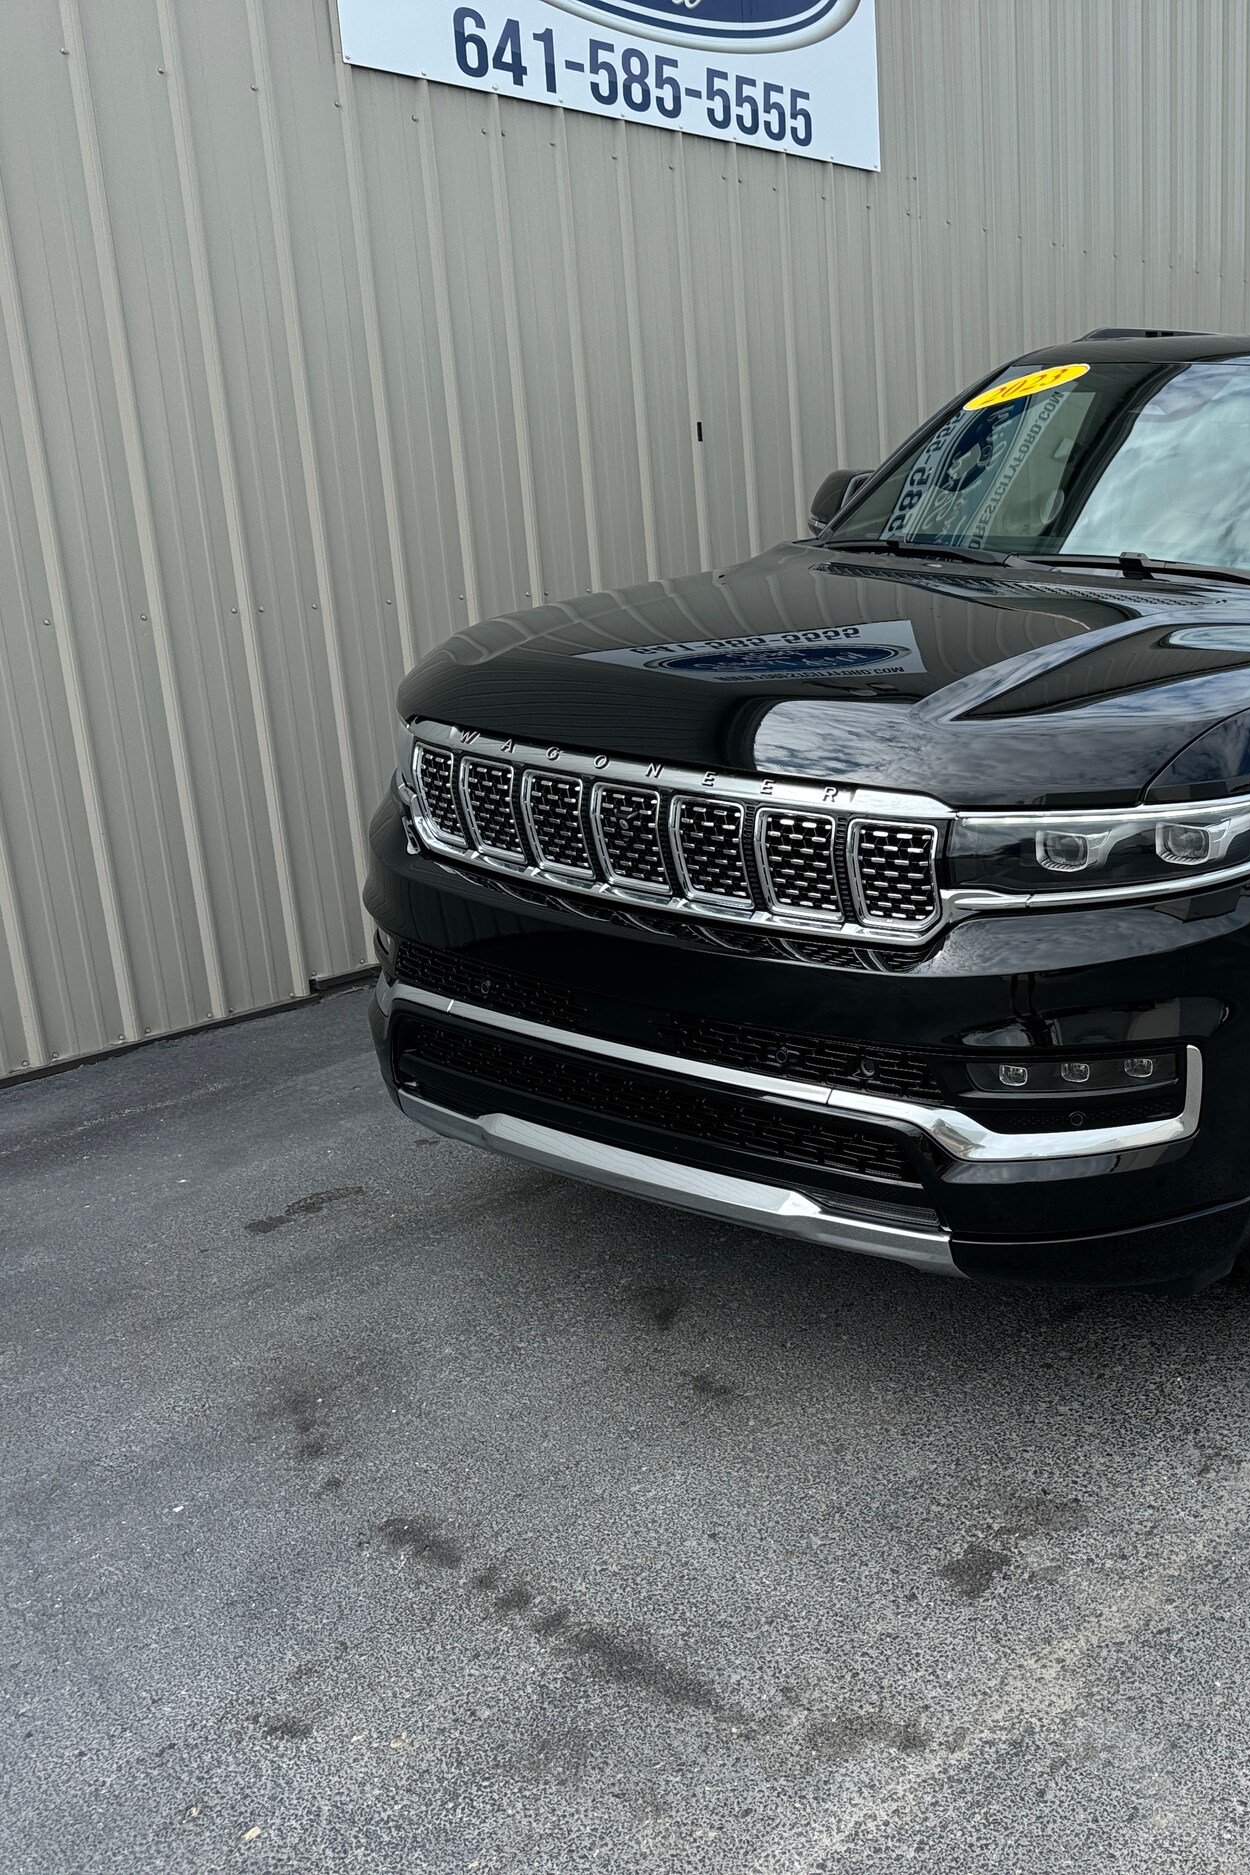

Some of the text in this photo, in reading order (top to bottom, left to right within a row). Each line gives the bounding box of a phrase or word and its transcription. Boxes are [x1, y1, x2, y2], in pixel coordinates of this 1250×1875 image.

[452, 6, 814, 147] 641-585-5555
[979, 368, 1068, 406] 2023
[459, 729, 839, 804] WAGONEER
